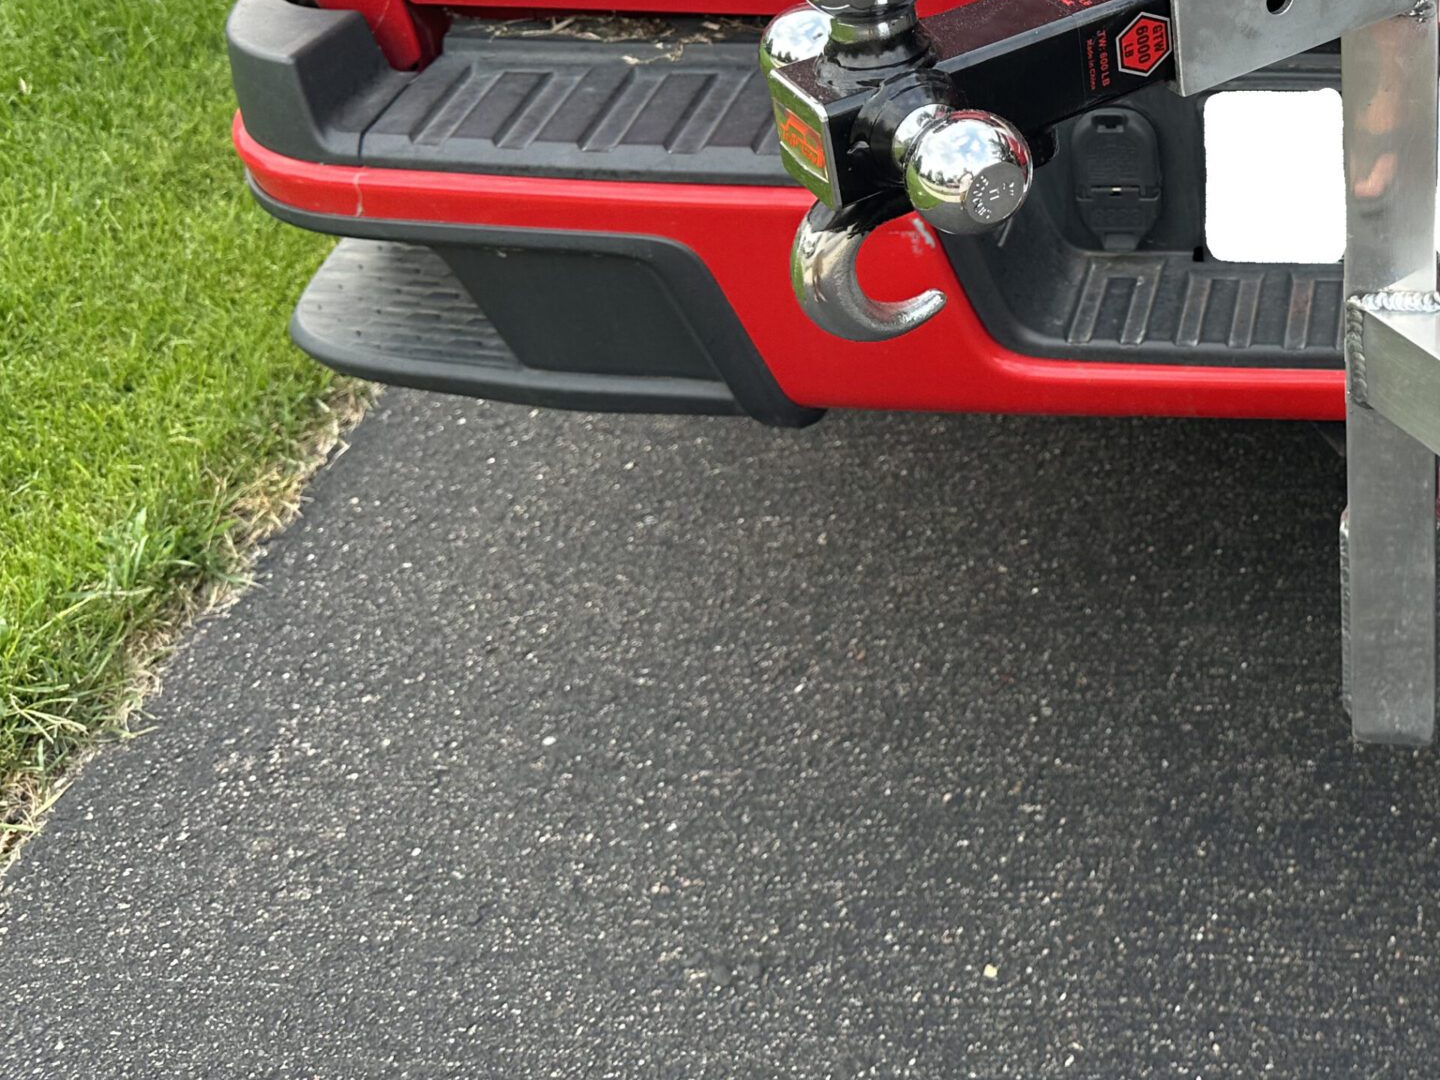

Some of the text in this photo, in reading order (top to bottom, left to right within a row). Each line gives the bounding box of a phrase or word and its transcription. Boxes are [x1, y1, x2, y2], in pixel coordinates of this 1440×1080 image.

[1136, 25, 1151, 64] 6000
[1152, 24, 1165, 52] GTW
[1123, 42, 1135, 58] LB
[1101, 74, 1111, 87] LB
